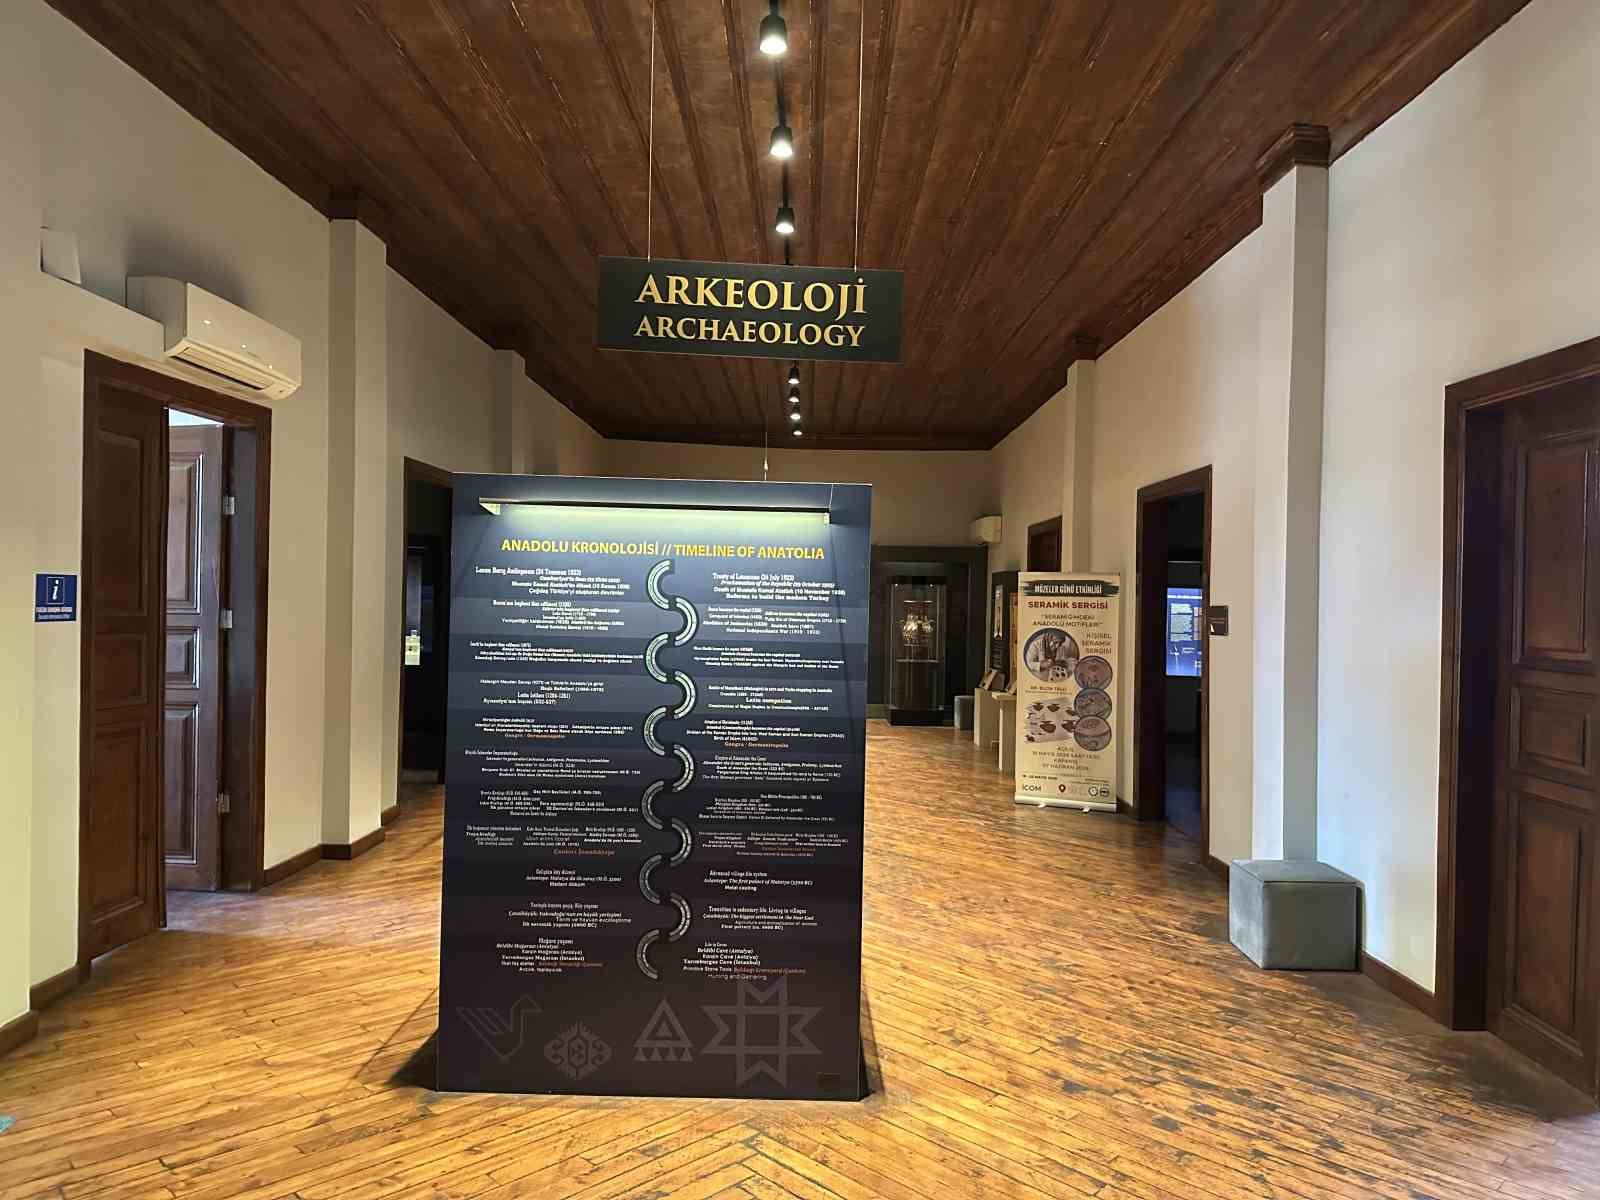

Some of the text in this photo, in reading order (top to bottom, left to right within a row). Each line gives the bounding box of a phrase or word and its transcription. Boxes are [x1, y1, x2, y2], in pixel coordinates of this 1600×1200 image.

[634, 315, 866, 347] ARCHAEOLOGY
[502, 539, 568, 552] ANADOLU
[572, 540, 658, 555] KRONOLOJİSİ
[674, 544, 734, 557] TIMELINE
[737, 545, 755, 557] OF
[758, 546, 824, 560] ANATOLIA
[1027, 600, 1108, 610] SERAMİK SERGİSİ
